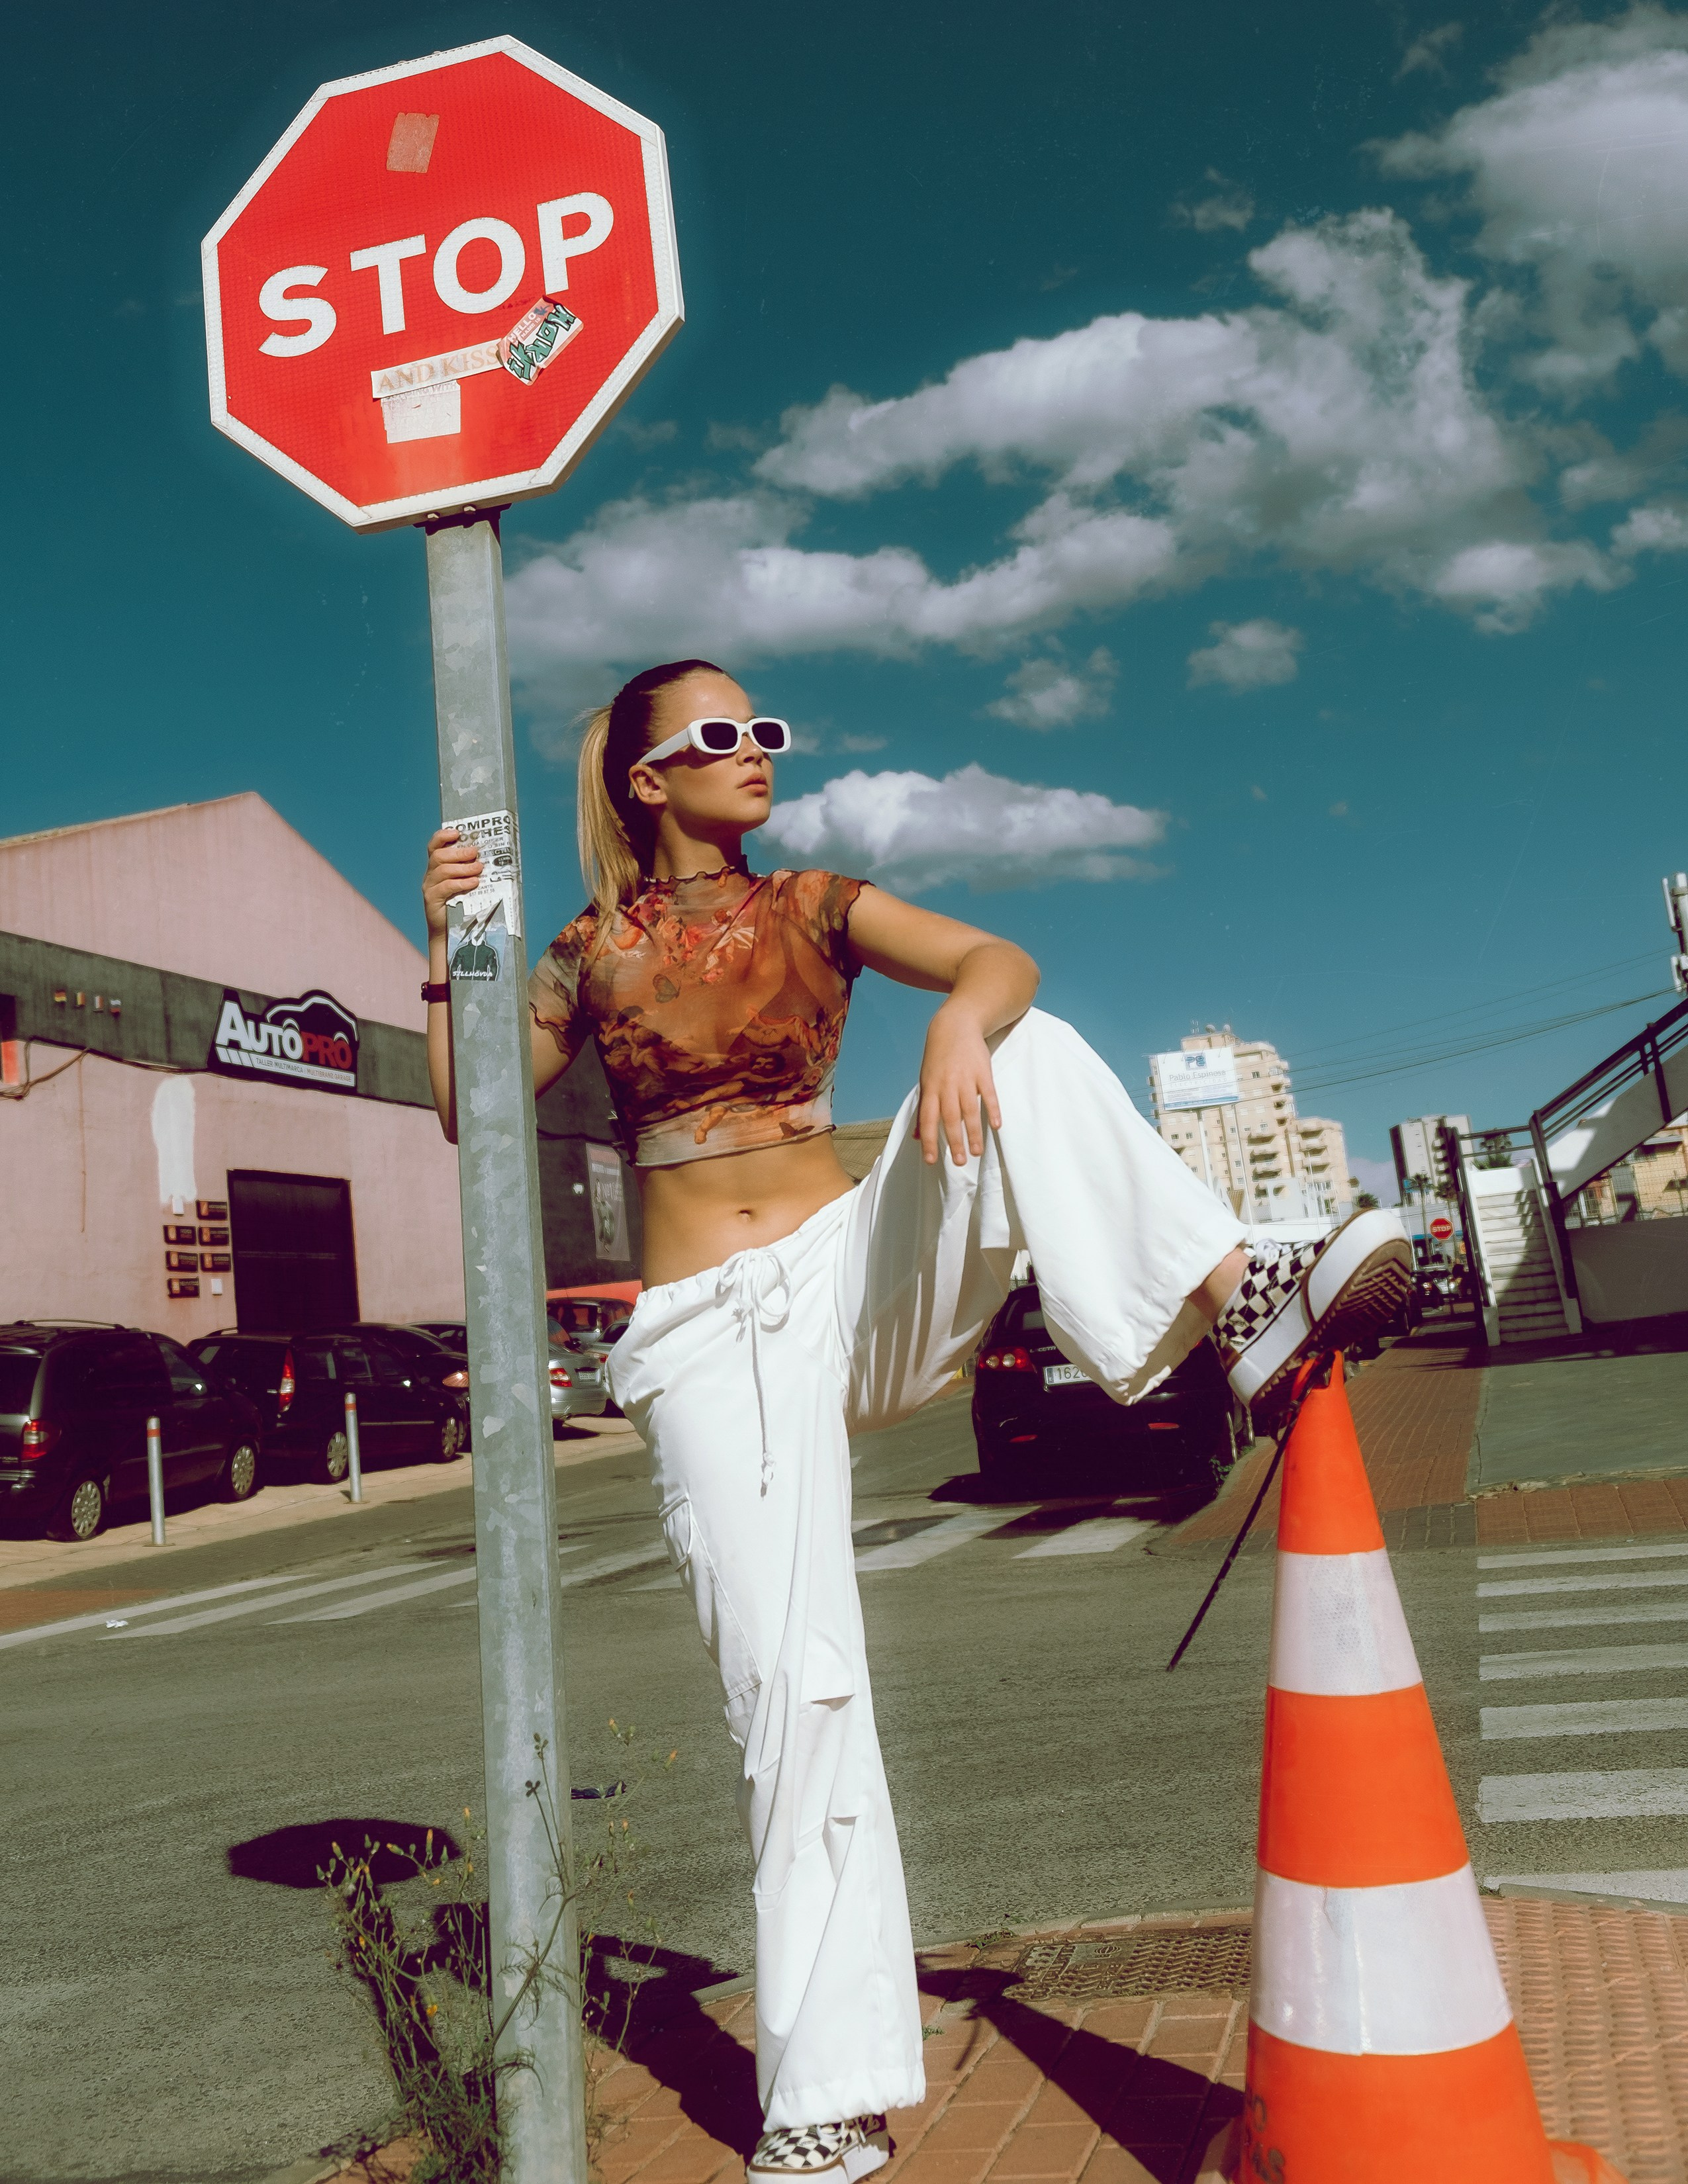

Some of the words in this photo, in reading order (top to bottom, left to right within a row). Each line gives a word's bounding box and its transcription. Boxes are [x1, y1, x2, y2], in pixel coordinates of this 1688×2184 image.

[258, 192, 614, 358] STOP
[507, 311, 536, 344] HELLO
[377, 362, 436, 394] AND
[440, 345, 498, 378] KISS
[458, 825, 511, 842] OCHES
[256, 1058, 273, 1067] TALLER
[274, 1060, 304, 1073] MULTIMARCA
[1169, 1073, 1191, 1081] Pablo
[1056, 1366, 1089, 1381] 162
